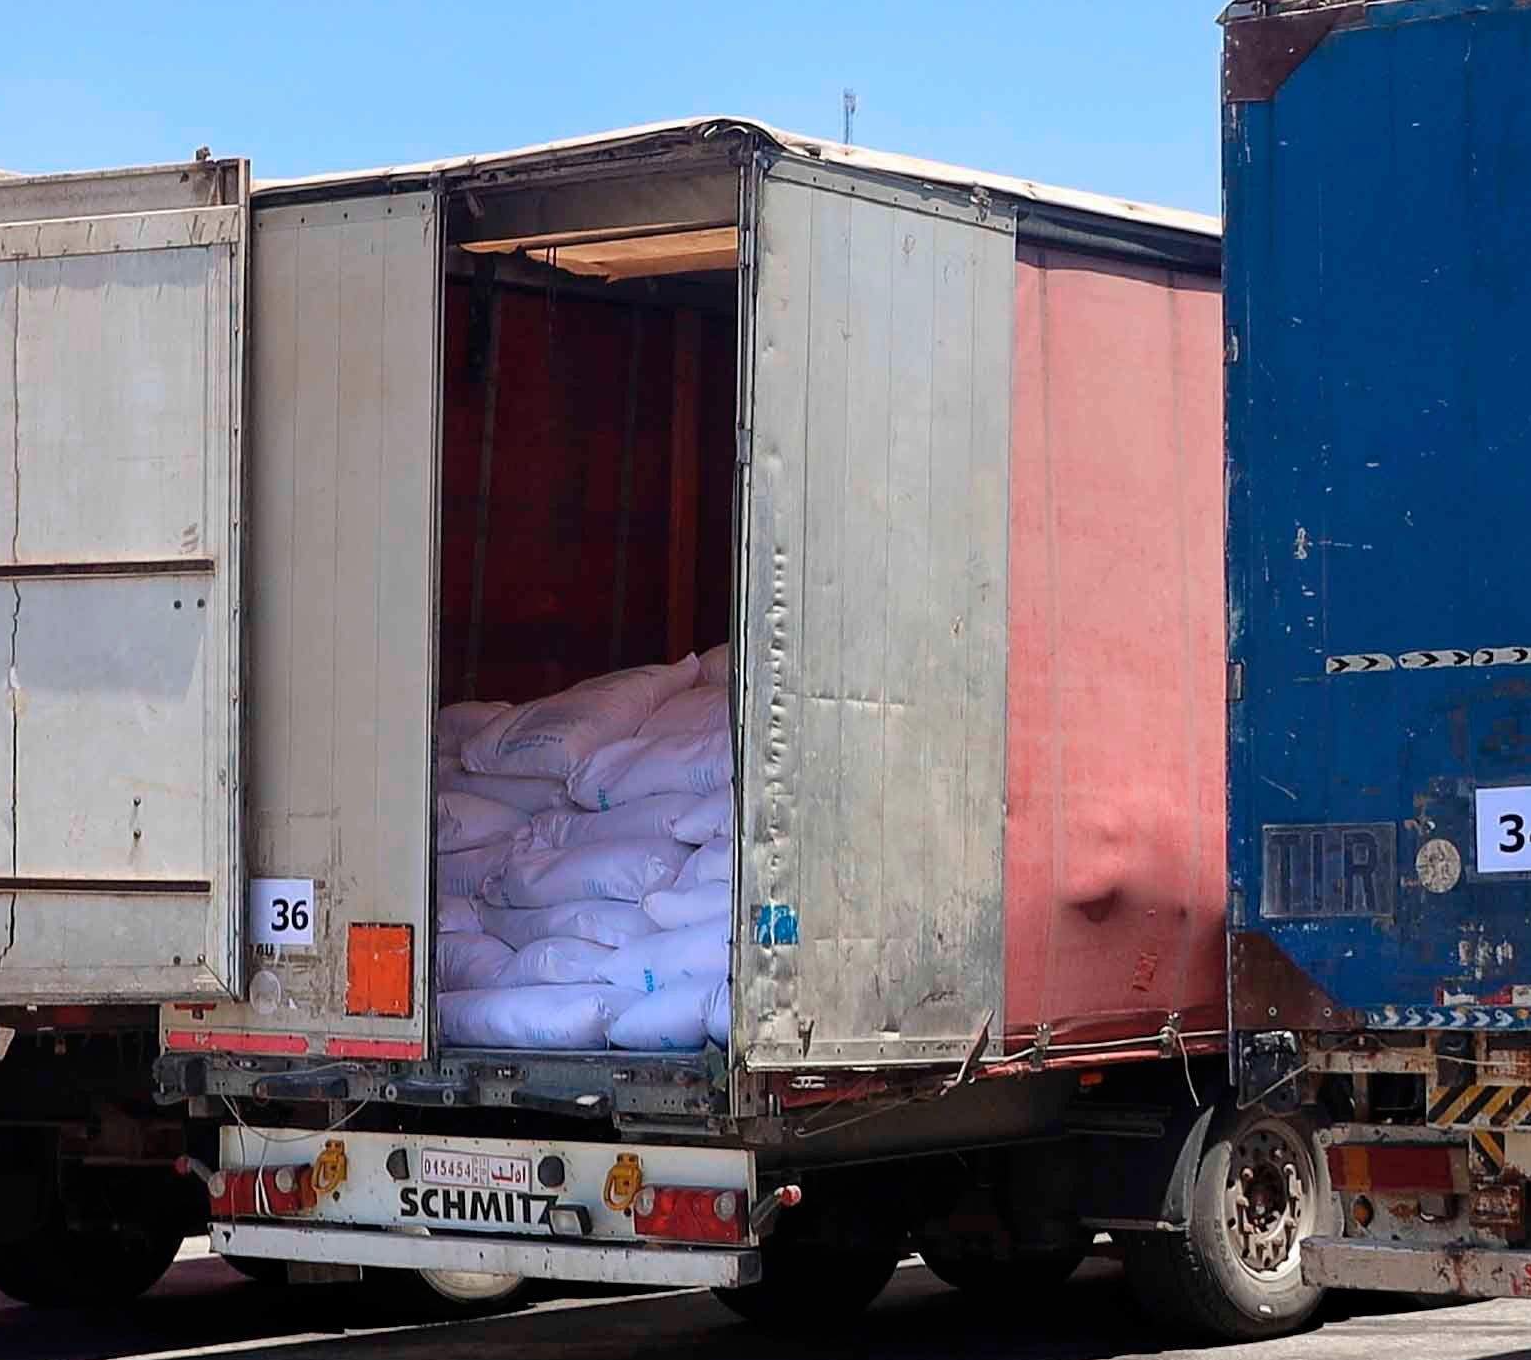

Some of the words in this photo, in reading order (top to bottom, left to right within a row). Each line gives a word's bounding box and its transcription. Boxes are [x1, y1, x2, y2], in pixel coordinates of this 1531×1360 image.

[1269, 831, 1381, 915] TIR
[270, 898, 310, 932] 36
[423, 1158, 471, 1179] 015454
[399, 1186, 560, 1226] SCHMITZ
